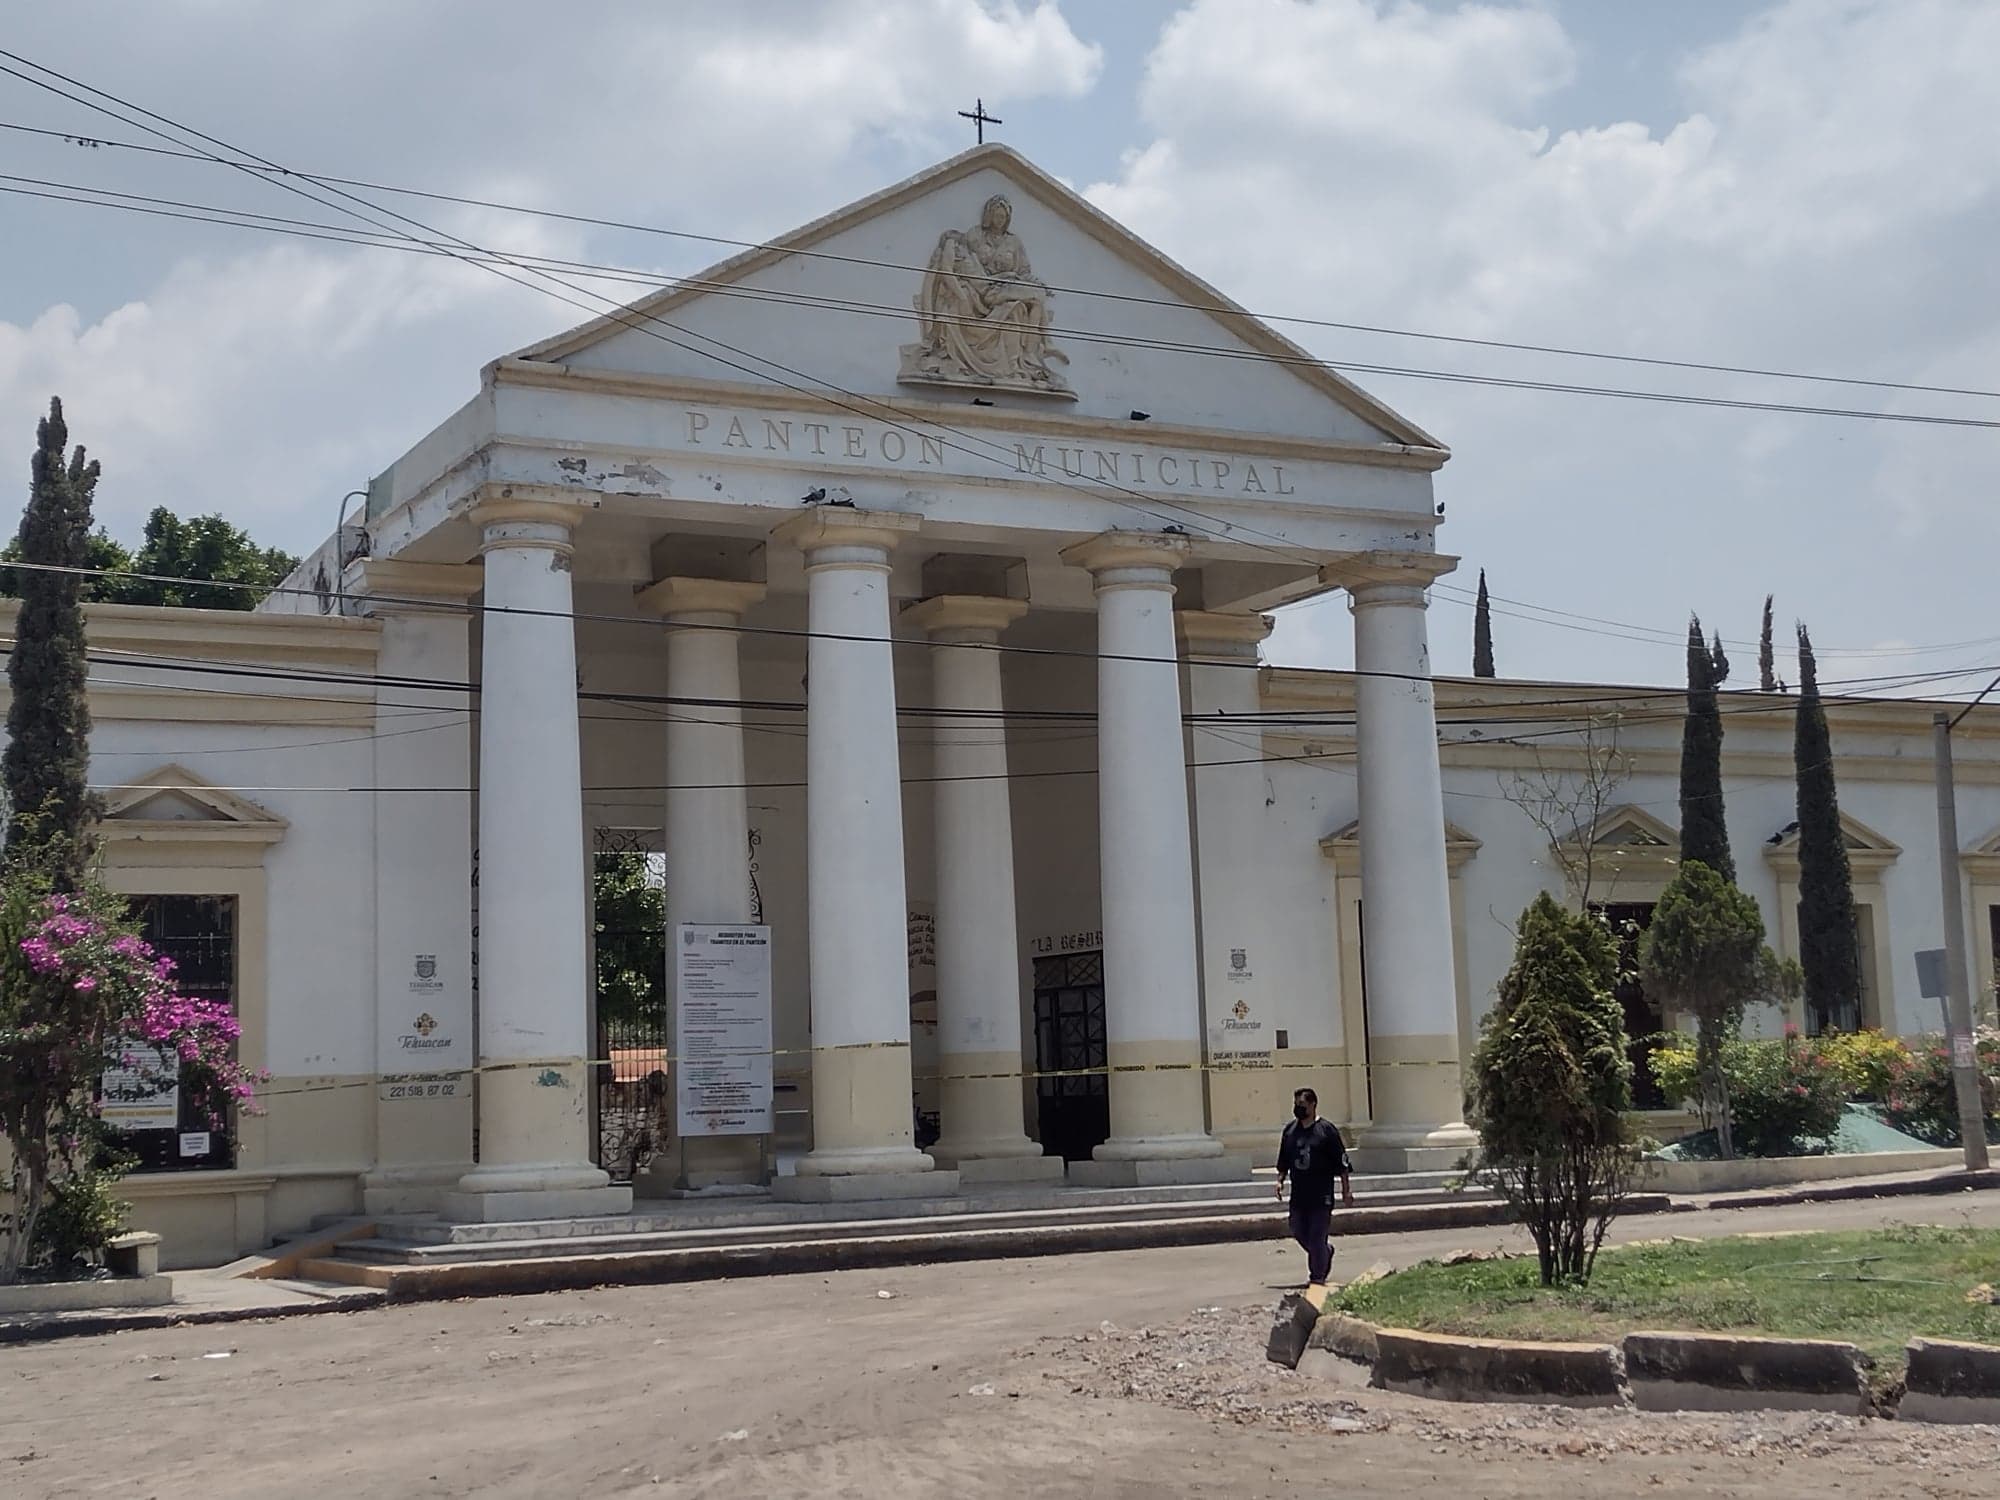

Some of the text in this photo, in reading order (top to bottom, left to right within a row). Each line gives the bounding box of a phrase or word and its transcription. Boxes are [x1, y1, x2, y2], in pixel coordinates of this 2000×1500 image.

[685, 410, 1297, 496] PANTEON MUNICIPAL
[428, 1085, 440, 1096] 87
[442, 1084, 455, 1096] 02
